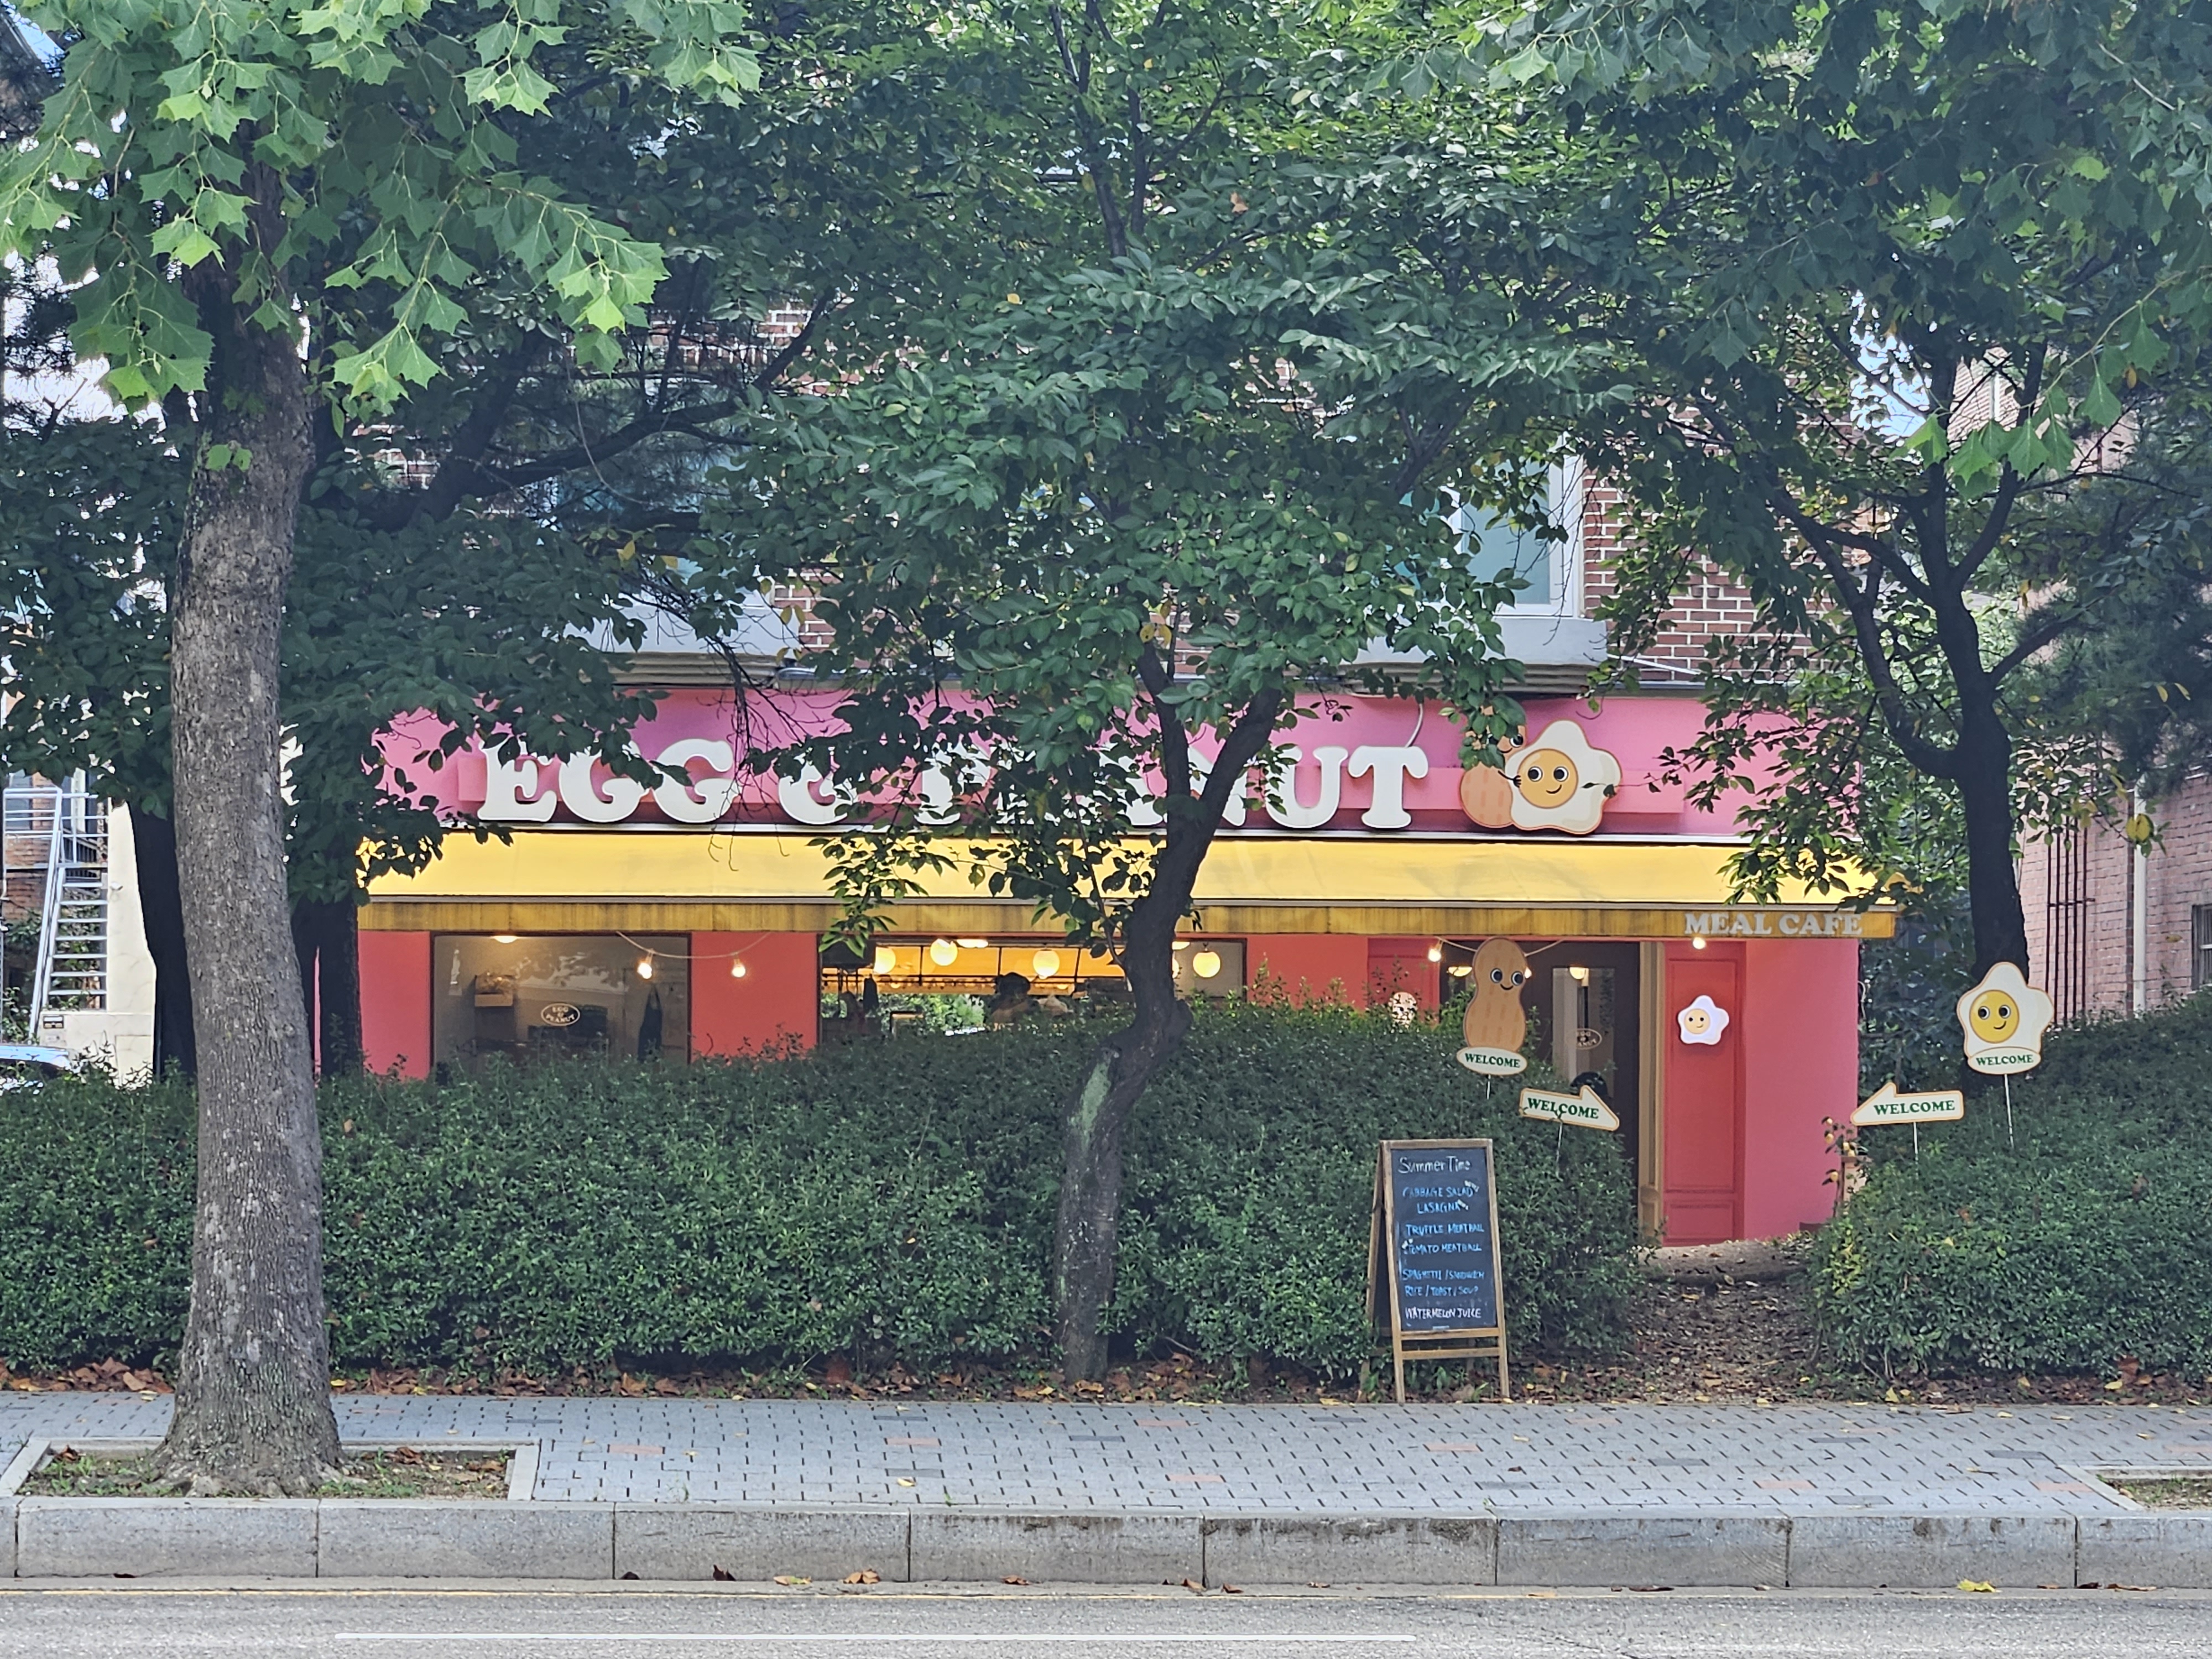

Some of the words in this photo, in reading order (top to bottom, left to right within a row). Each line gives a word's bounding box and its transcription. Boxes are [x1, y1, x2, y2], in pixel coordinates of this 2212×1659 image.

[477, 738, 740, 823] EGG
[1684, 912, 1772, 935] MEAL
[1778, 912, 1863, 935] CAFE
[546, 1014, 575, 1022] PEANUT
[1464, 1052, 1521, 1068] WELCOME
[1976, 1054, 2034, 1066] WELCOME
[1527, 1097, 1600, 1119] WELCOME
[1874, 1100, 1955, 1115] WELCOME
[1397, 1157, 1446, 1173] Summer
[1402, 1187, 1443, 1198] CABBAGE
[1446, 1187, 1473, 1198] SALAD
[1417, 1202, 1460, 1214] LASAGNA
[1406, 1224, 1444, 1237] TRUFFLE
[1448, 1223, 1484, 1234] MEATBALL
[1408, 1244, 1439, 1255] TOMATO
[1441, 1243, 1482, 1253] MEATBALL
[1405, 1306, 1456, 1319] WATERMELON
[1457, 1308, 1481, 1318] JUICE
